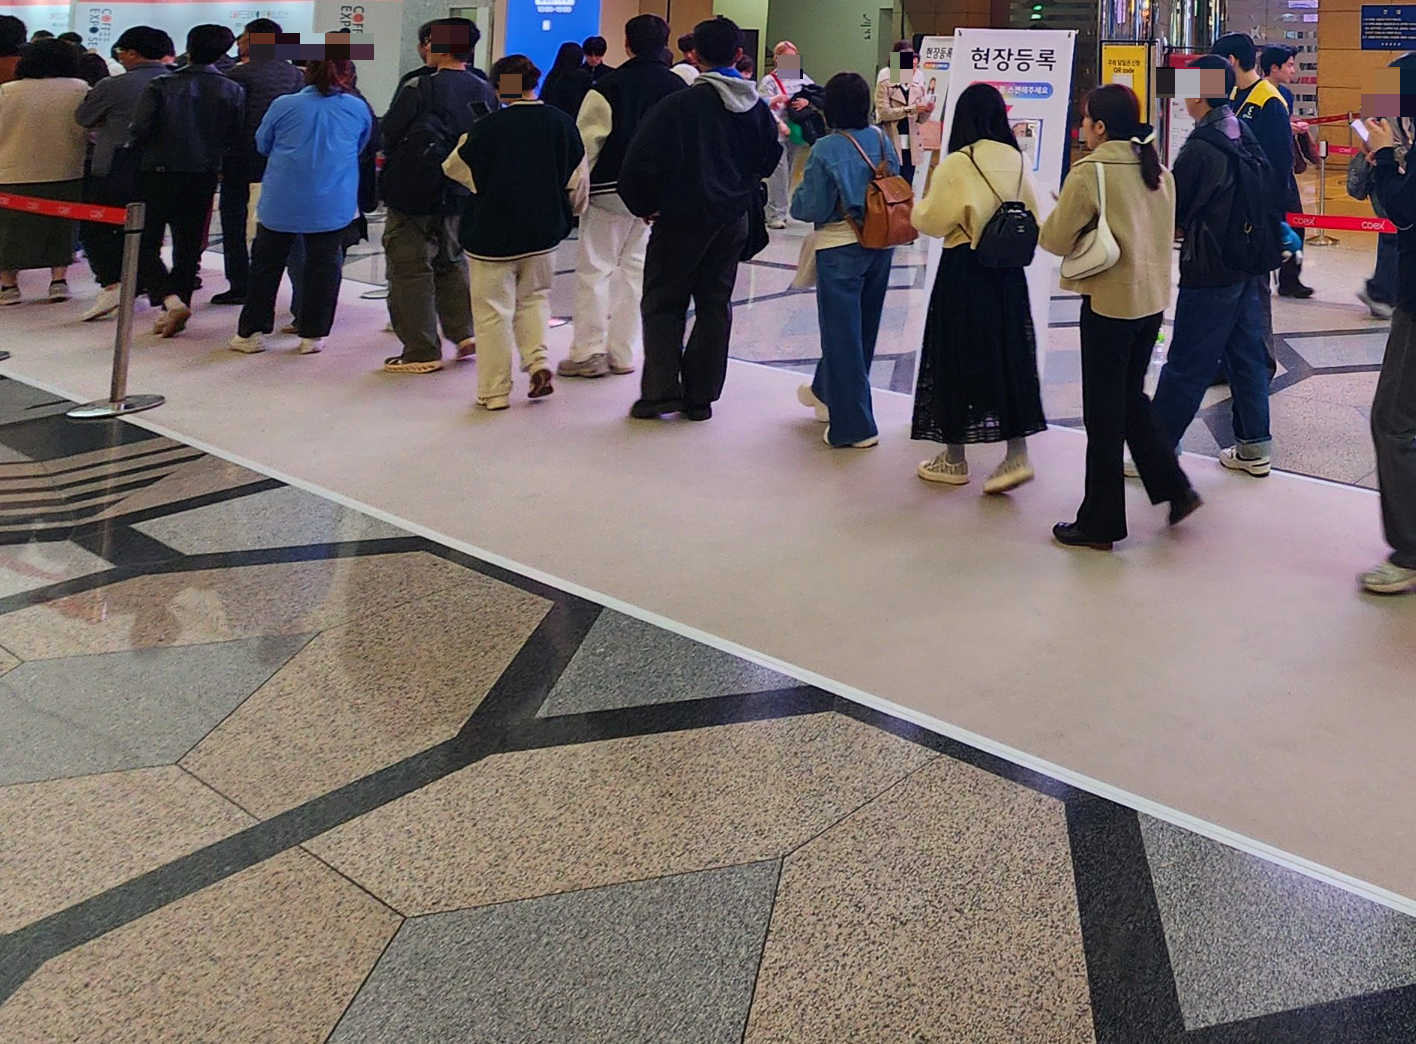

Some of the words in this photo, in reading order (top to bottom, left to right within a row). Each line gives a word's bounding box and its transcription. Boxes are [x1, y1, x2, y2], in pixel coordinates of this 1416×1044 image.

[353, 5, 365, 33] COFF
[971, 47, 1057, 72] 현장등록
[1292, 216, 1315, 226] coex
[1361, 220, 1385, 231] coex
